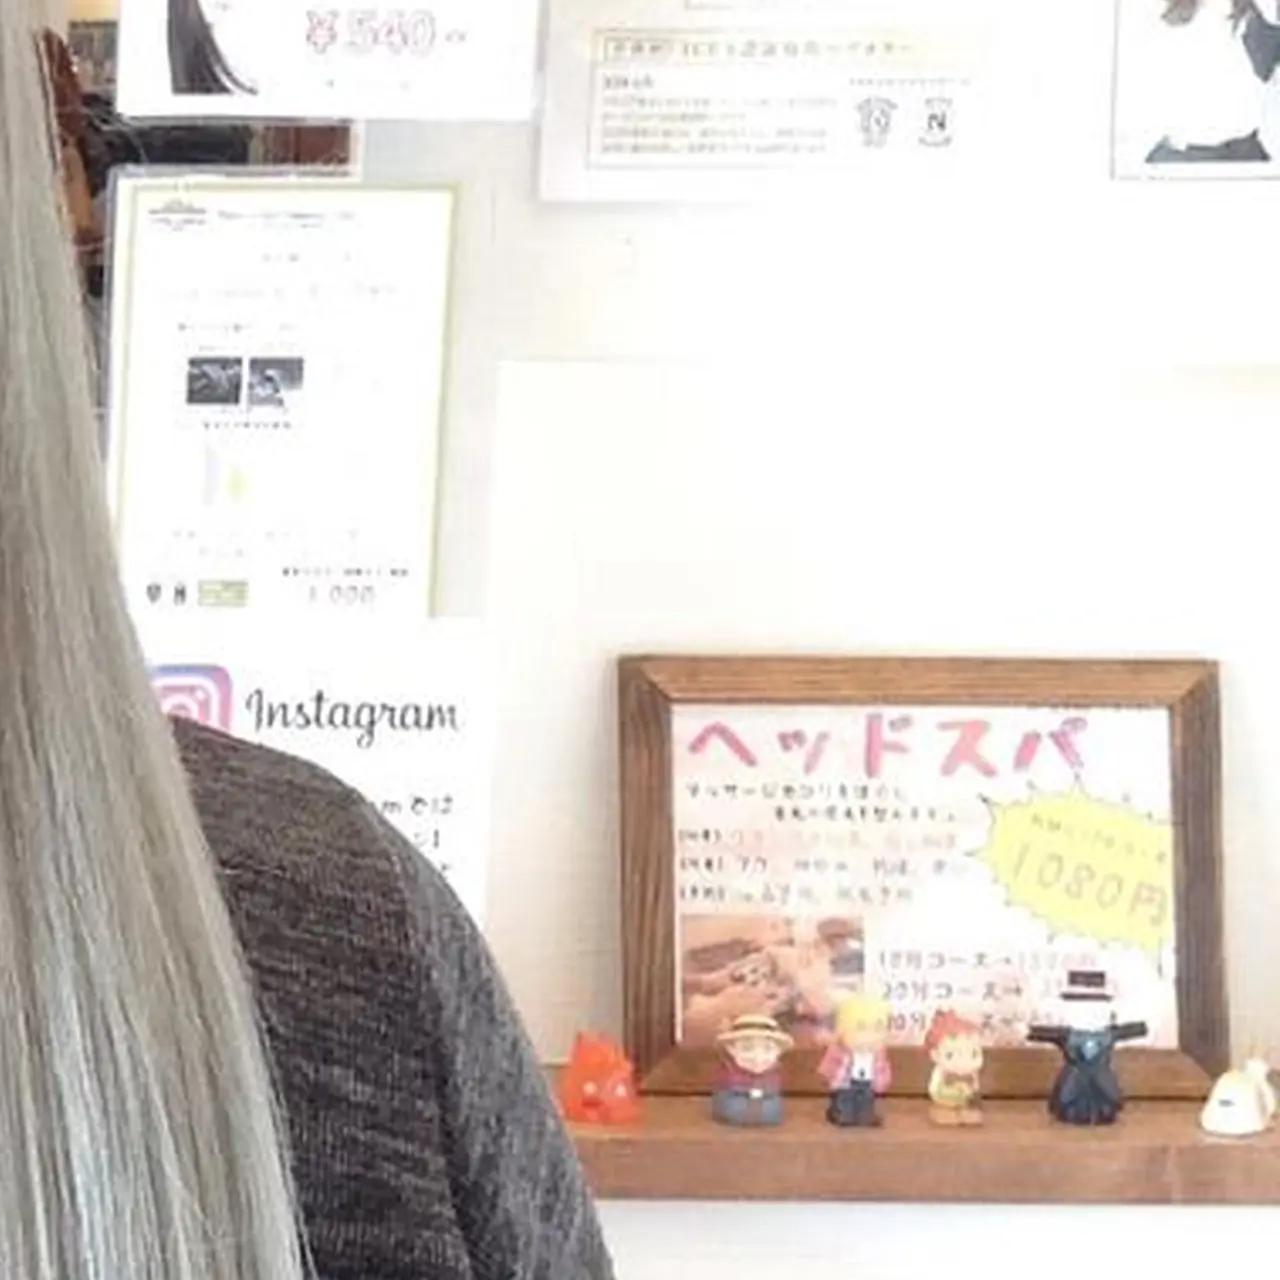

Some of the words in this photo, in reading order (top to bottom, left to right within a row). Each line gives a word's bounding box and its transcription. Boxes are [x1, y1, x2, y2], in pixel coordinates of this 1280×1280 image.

[243, 687, 463, 749] Instagram
[687, 713, 1089, 778] ヘッドスパ
[1012, 840, 1169, 927] 1080円
